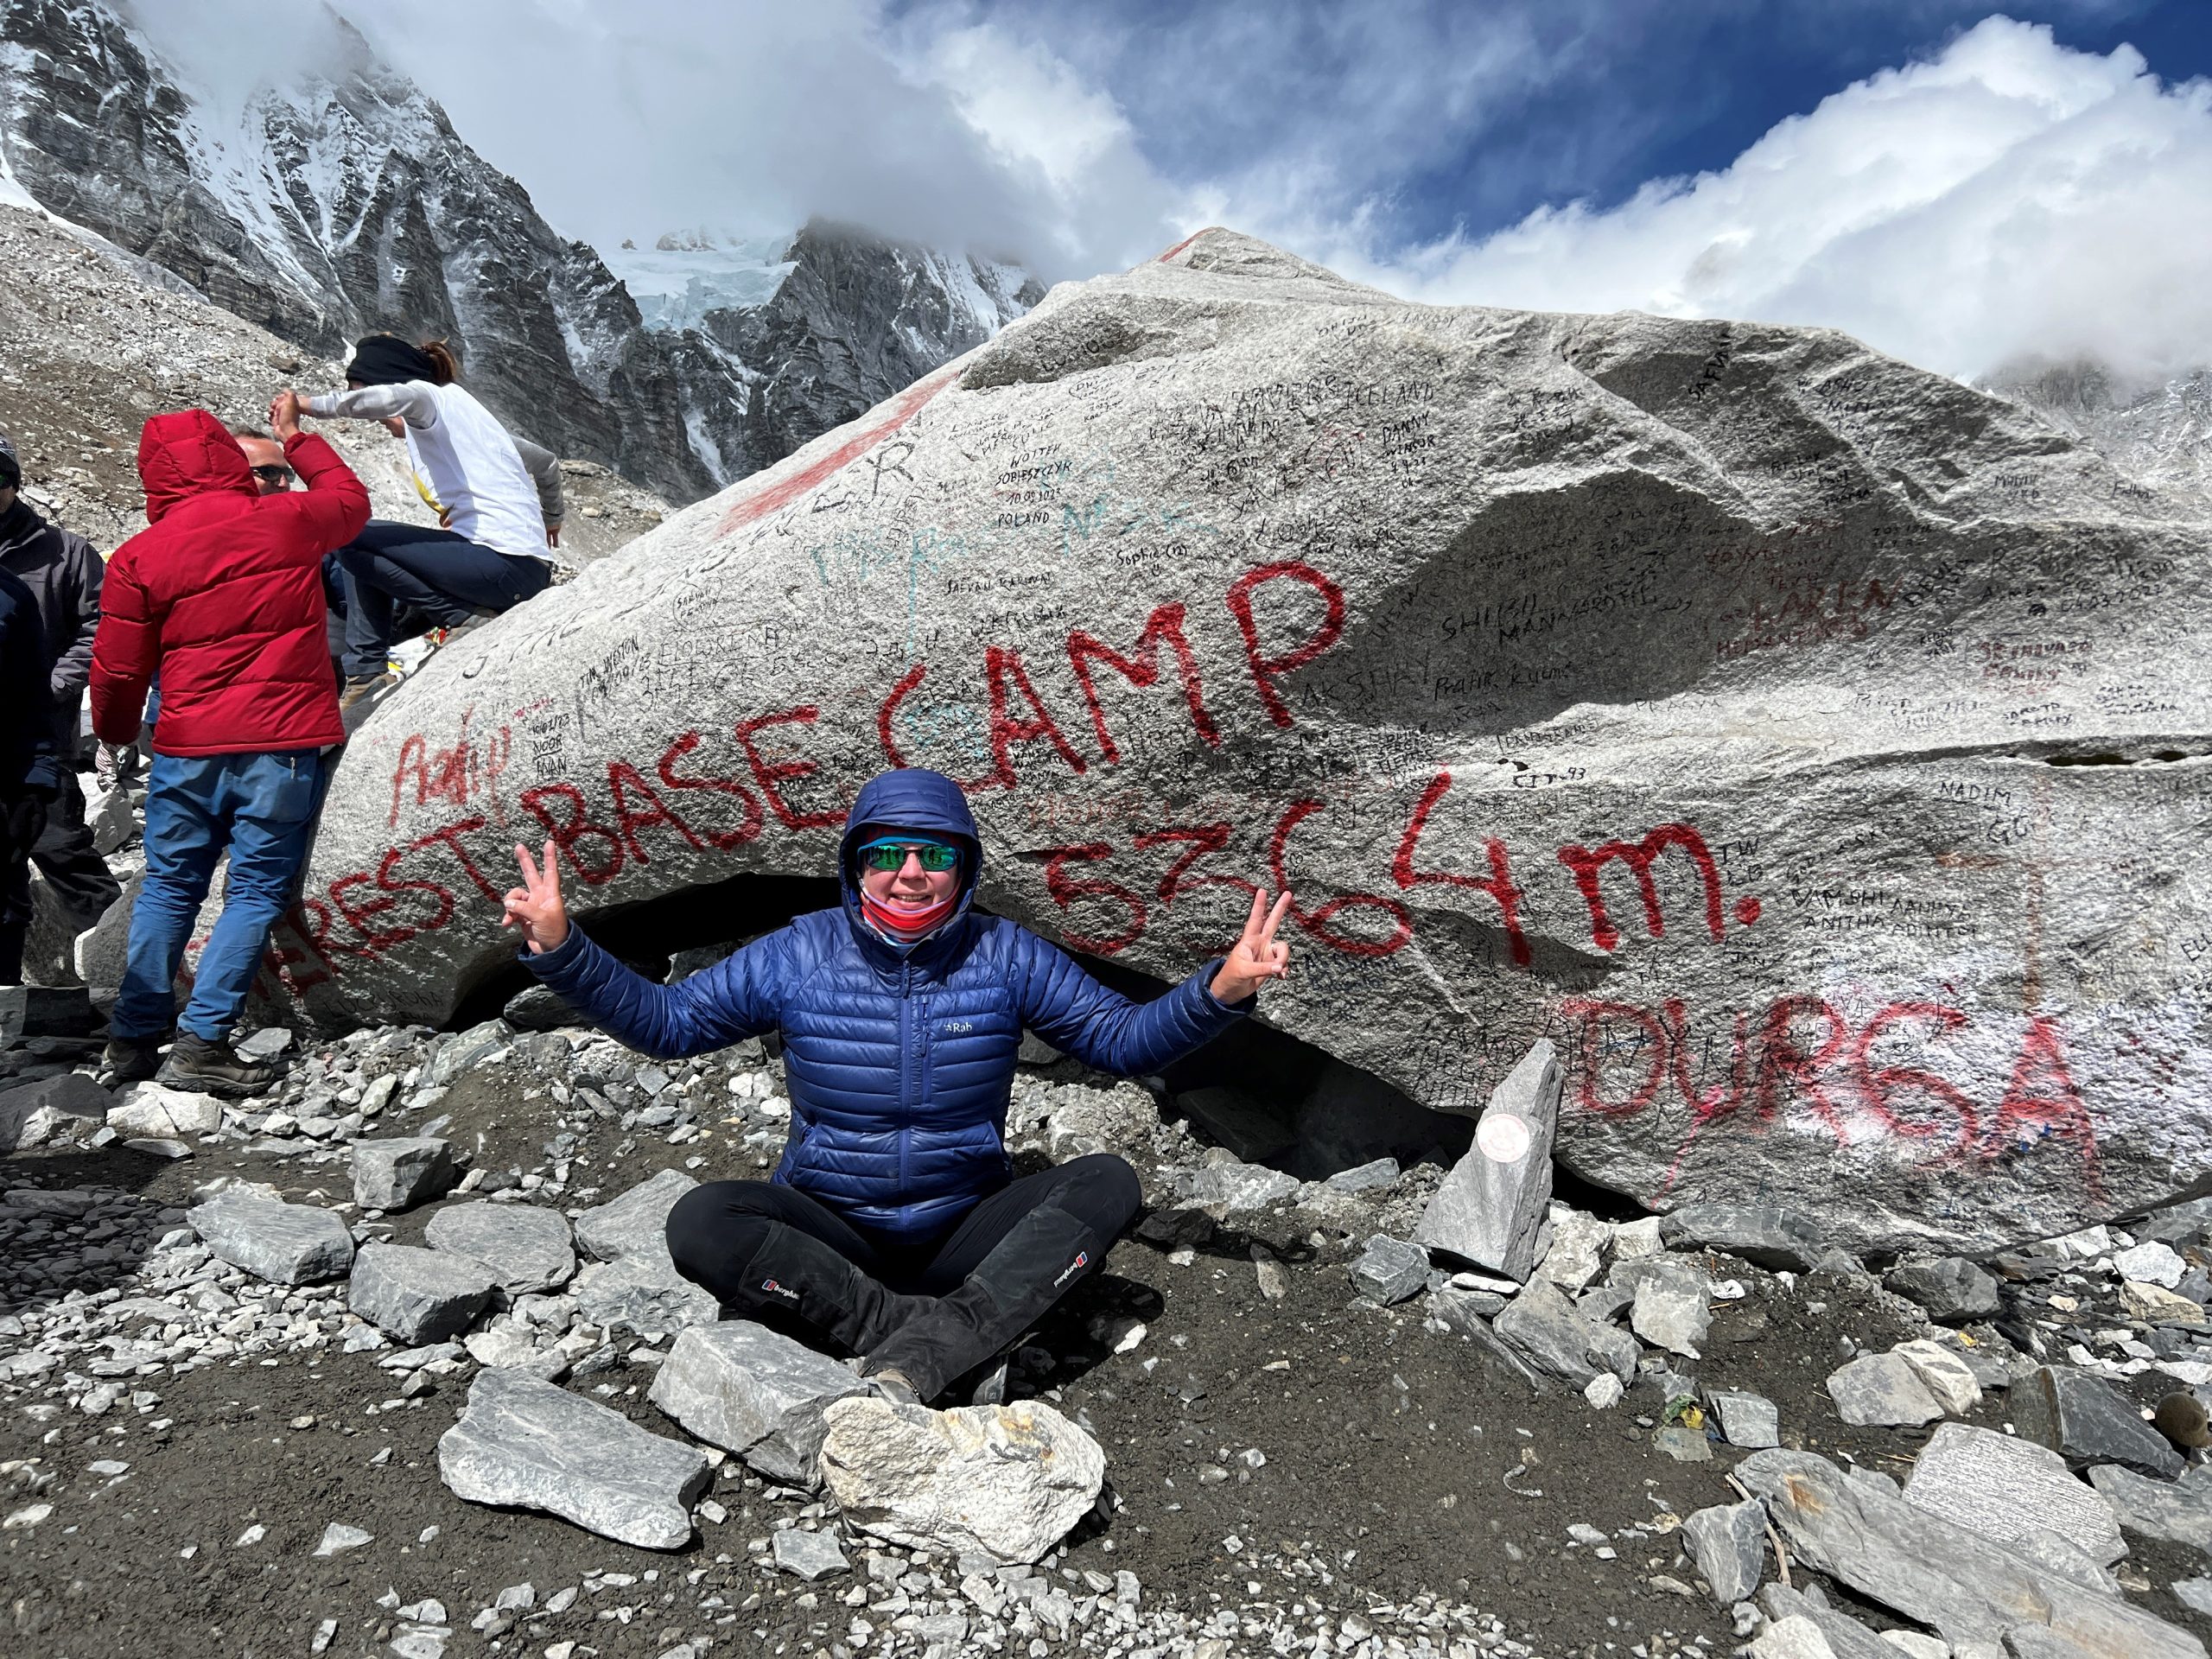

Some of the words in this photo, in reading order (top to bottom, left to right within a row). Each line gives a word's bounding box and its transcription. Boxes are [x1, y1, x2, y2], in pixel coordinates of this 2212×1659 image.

[1382, 410, 1430, 448] DANNY
[998, 511, 1050, 529] POLAND
[520, 703, 850, 886] BASE
[879, 560, 1344, 793] CAMP
[1940, 779, 2012, 804] NADIM
[953, 1021, 972, 1033] Rab
[1555, 994, 2110, 1210] DURGA
